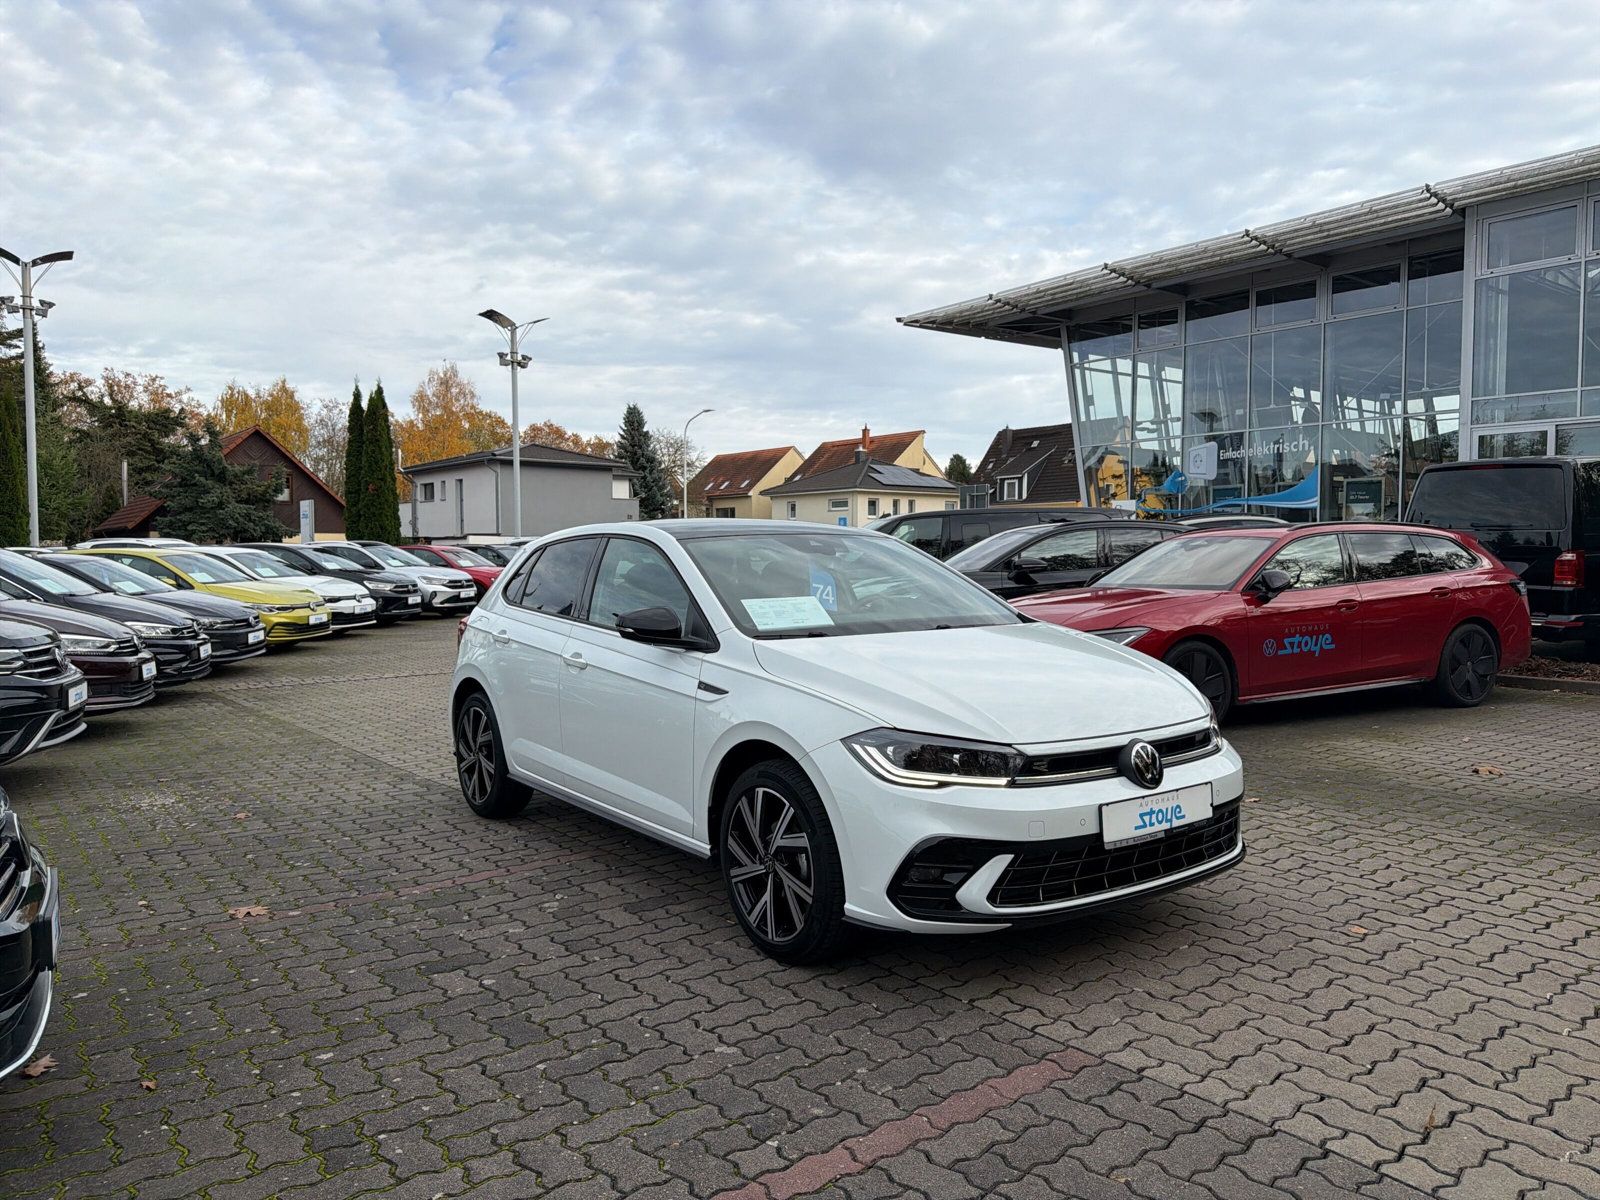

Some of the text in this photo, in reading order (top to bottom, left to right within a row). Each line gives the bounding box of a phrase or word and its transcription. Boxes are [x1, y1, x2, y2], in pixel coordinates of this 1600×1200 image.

[1220, 445, 1246, 460] Einfach
[812, 583, 834, 604] 74
[1284, 624, 1329, 633] AUTOHAUS
[1139, 794, 1179, 808] AUTOHAUS
